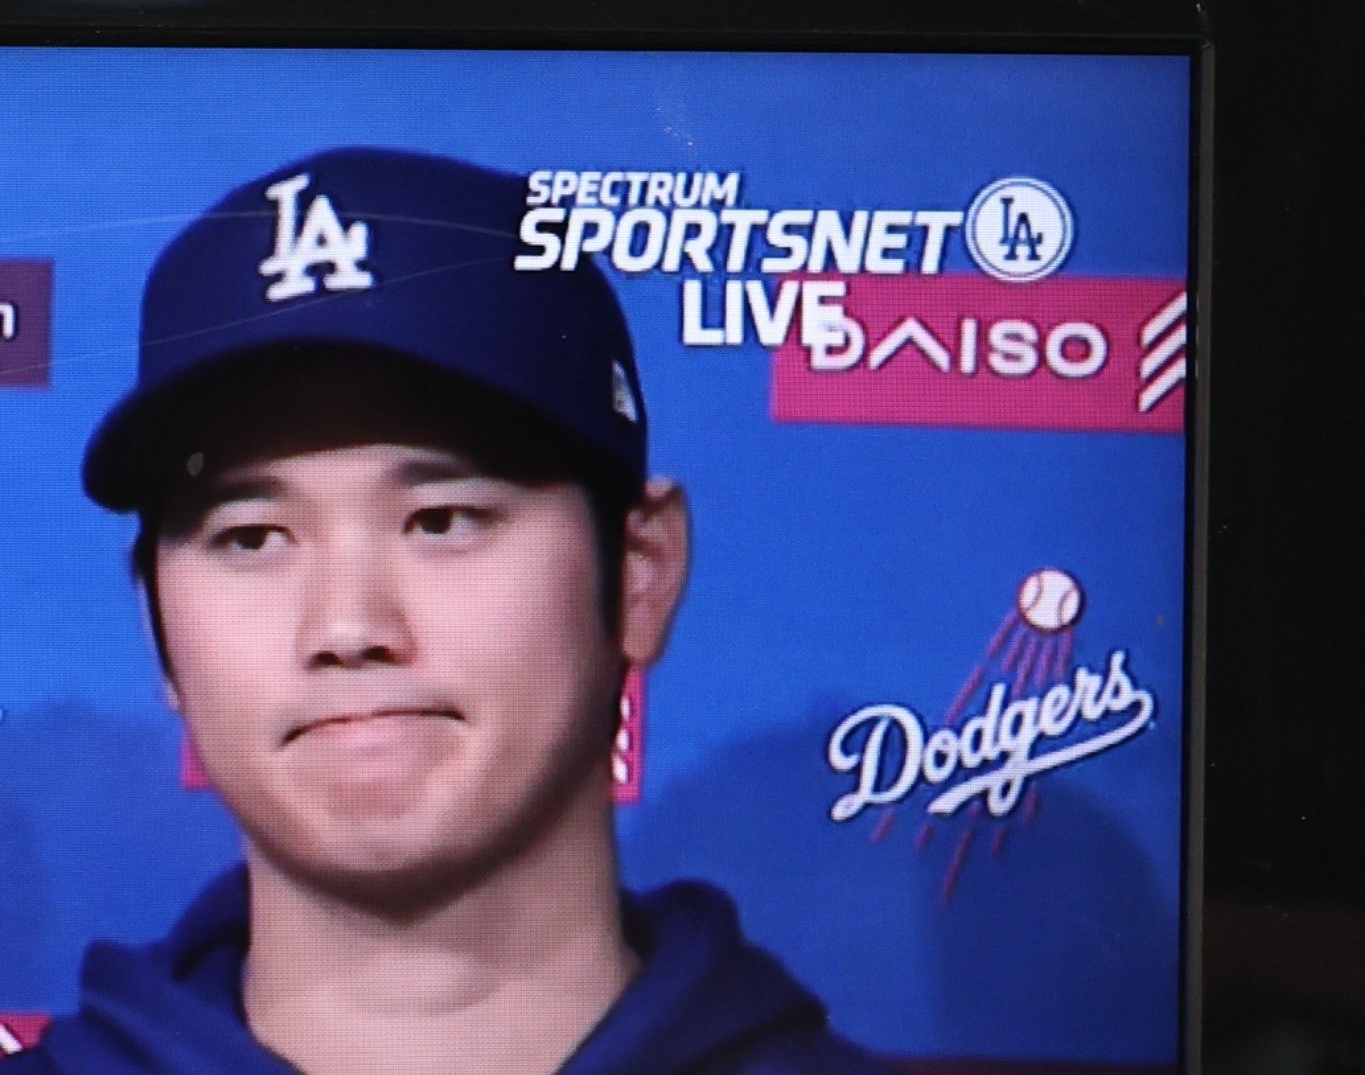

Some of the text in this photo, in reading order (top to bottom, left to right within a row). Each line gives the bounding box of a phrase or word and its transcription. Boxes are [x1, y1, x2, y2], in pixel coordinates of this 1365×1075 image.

[526, 170, 739, 207] SPECTRUM
[260, 175, 373, 300] LA
[514, 207, 964, 275] SPORTSNET
[994, 192, 1047, 264] LA
[679, 278, 851, 347] LIVE
[829, 651, 1153, 820] Dodgers
